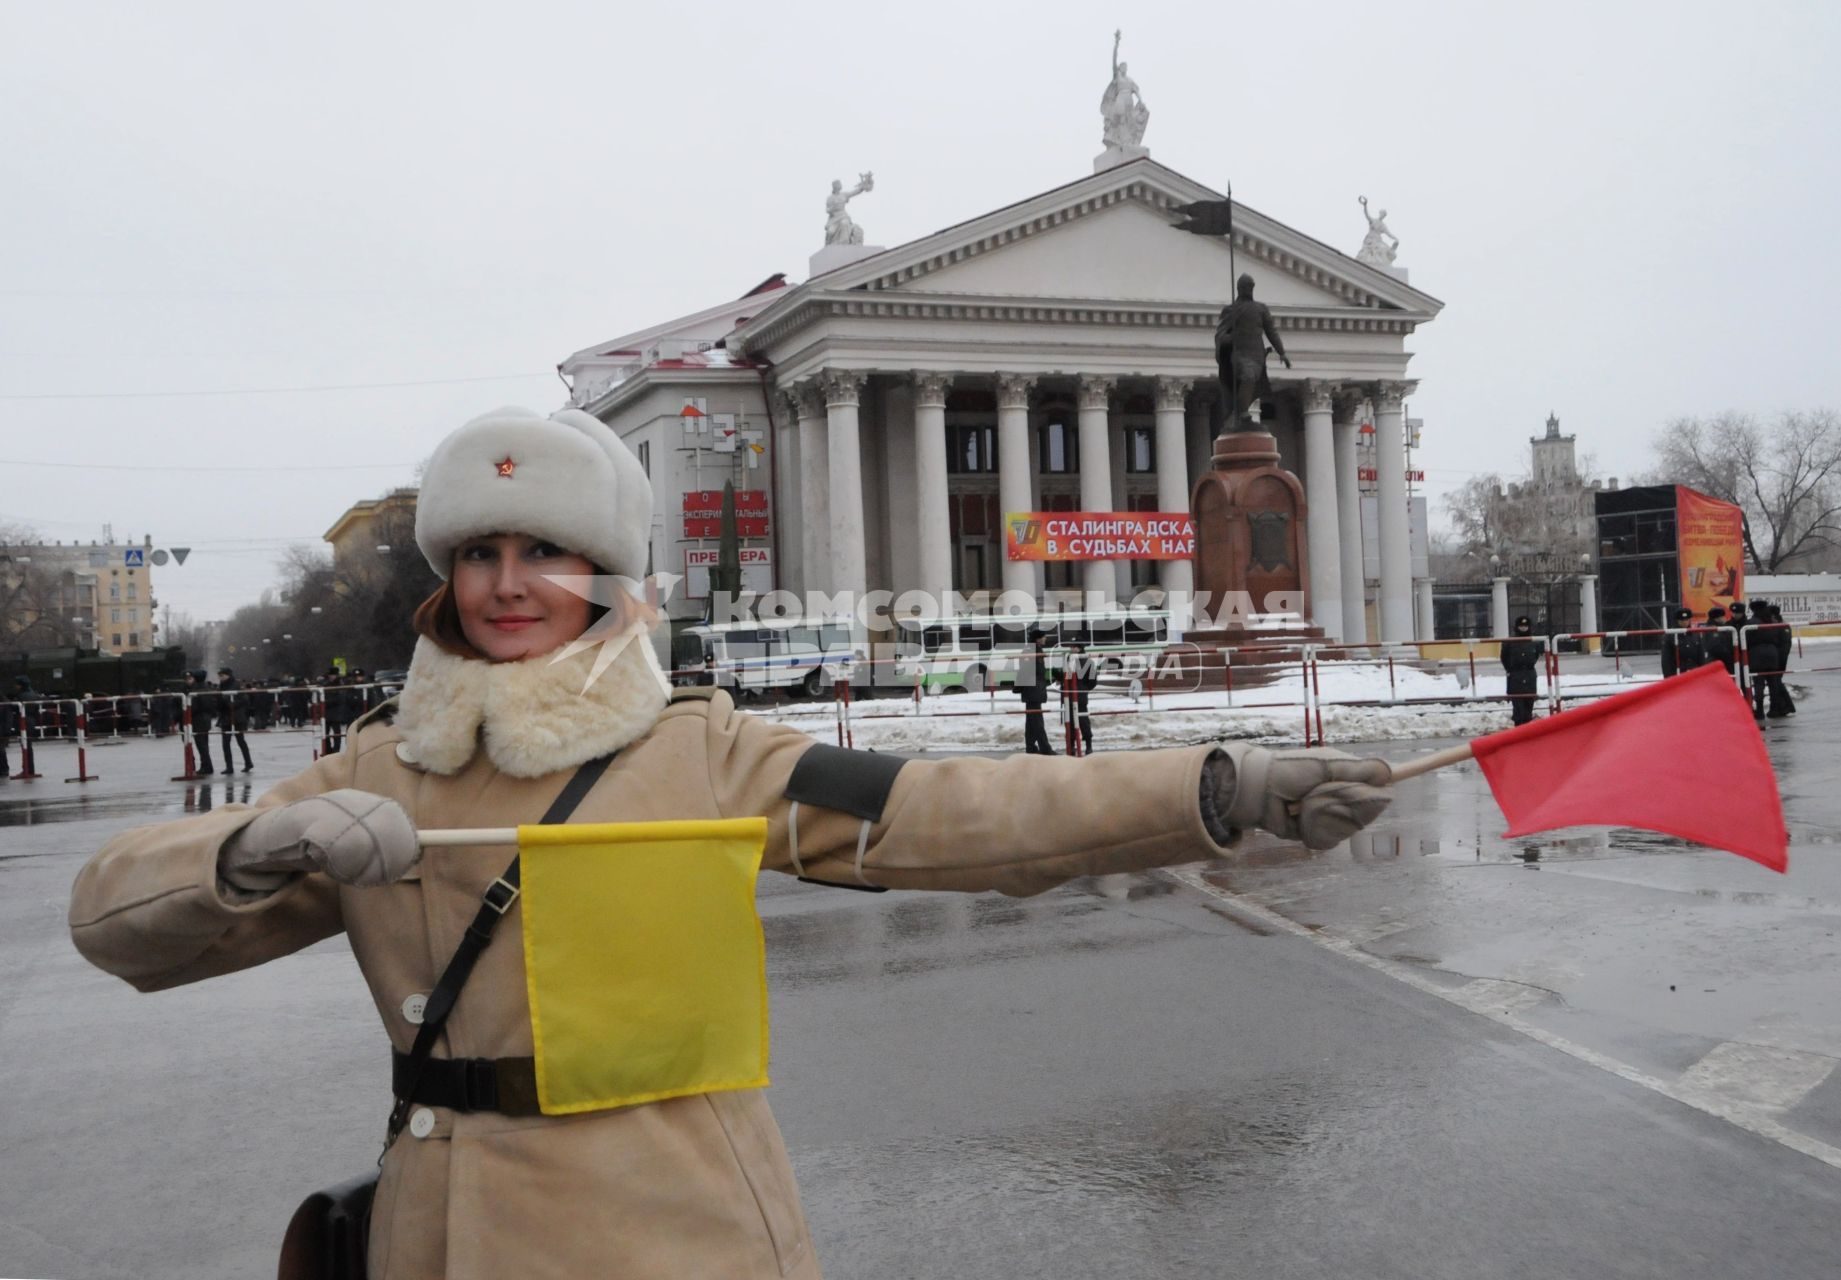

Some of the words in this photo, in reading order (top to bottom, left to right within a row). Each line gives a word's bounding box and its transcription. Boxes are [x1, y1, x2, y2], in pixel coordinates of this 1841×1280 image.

[684, 525, 769, 536] ТЕТР
[1047, 540, 1058, 555] В
[1069, 539, 1151, 557] СУДЬБАХ
[689, 550, 767, 563] ПРЕЕРА
